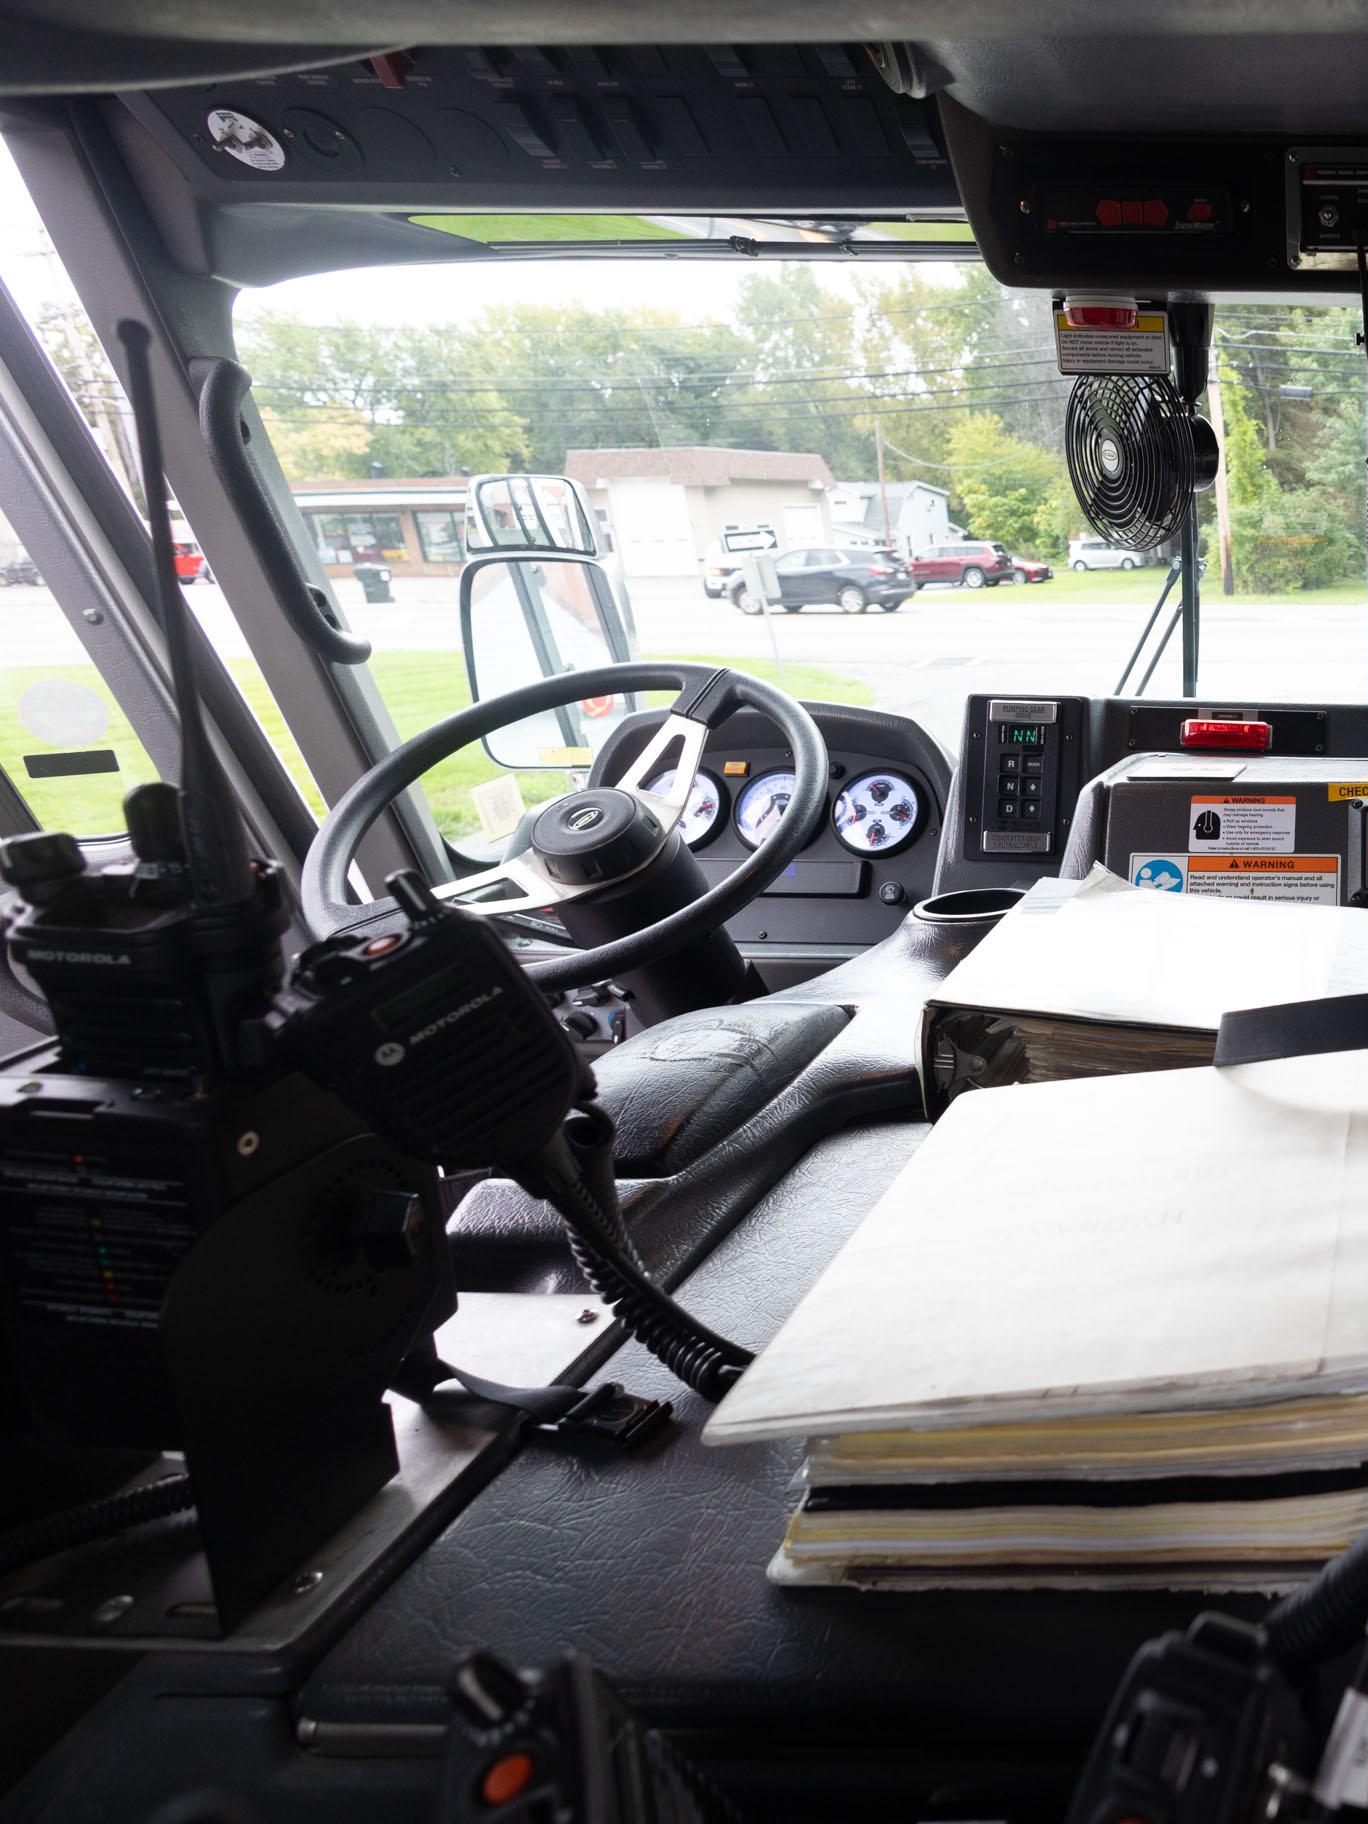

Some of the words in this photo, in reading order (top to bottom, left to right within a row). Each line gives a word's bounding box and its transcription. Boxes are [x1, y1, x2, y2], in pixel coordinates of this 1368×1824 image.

[1243, 860, 1295, 869] WARNING
[26, 949, 132, 966] MOTOROLA
[408, 986, 504, 1046] MOTOROLA
